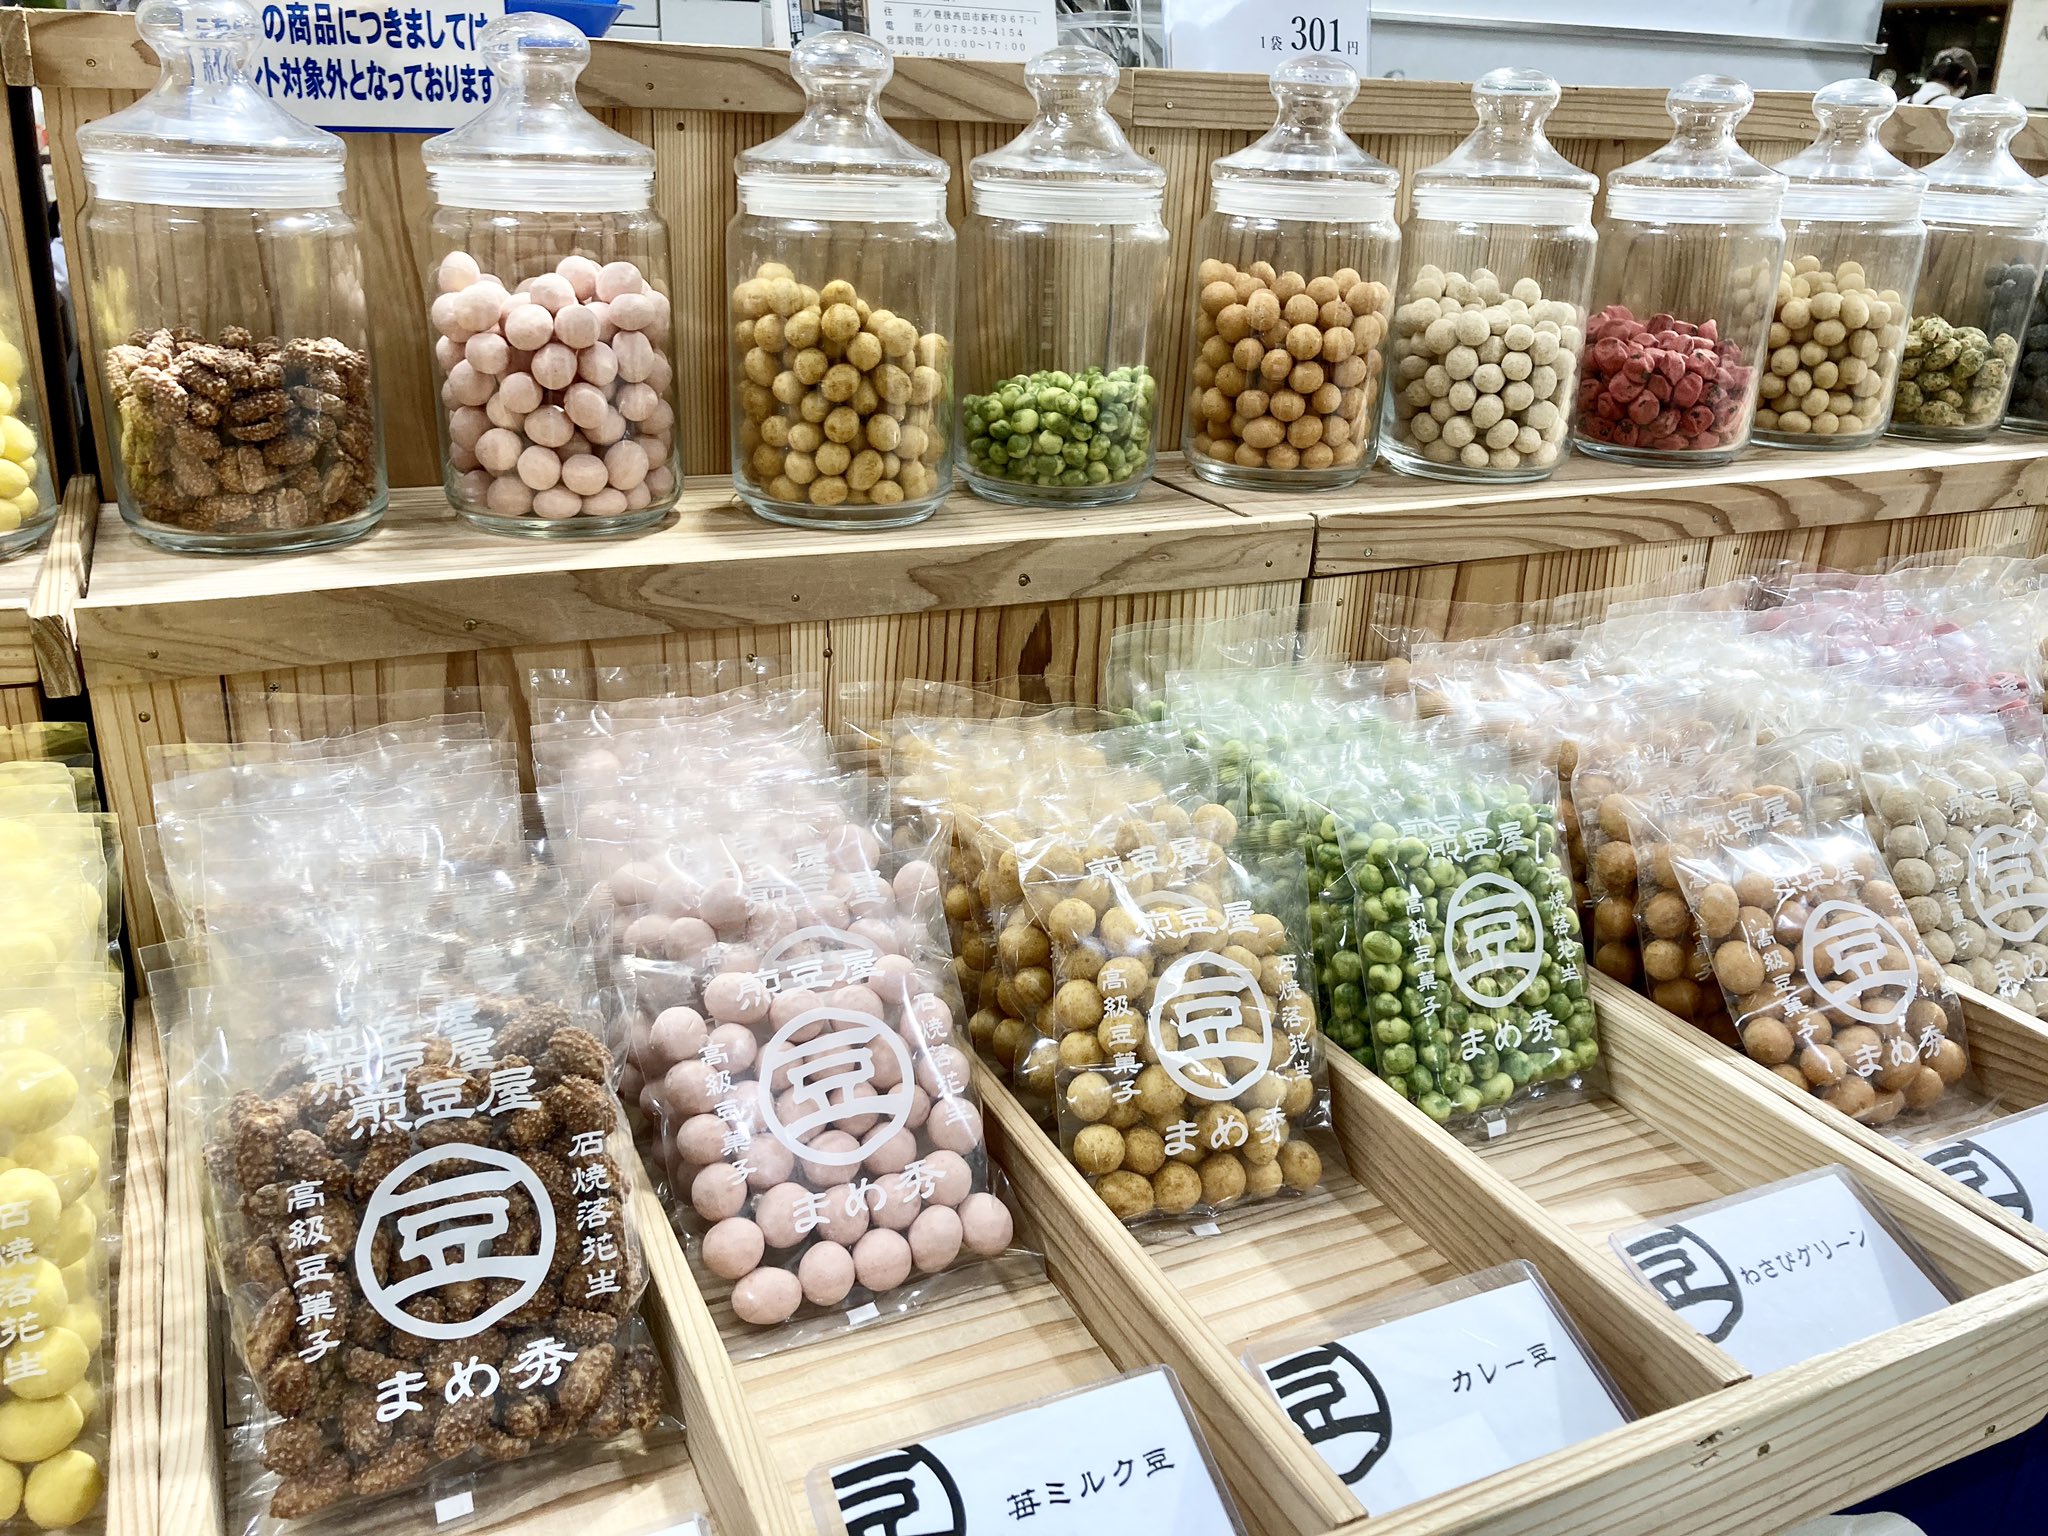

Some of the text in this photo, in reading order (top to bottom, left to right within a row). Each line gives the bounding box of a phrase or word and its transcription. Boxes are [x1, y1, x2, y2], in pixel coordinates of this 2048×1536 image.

[1406, 892, 1441, 1017] 高級豆菓子
[1101, 967, 1143, 1104] 高級豆菓子
[1462, 1010, 1560, 1061] まめ秀
[1857, 1024, 1946, 1077] まめ秀
[347, 1065, 542, 1140] 煎豆屋
[698, 1043, 757, 1185] 高級豆菓子
[569, 1130, 623, 1298] 石焼落花生
[793, 1159, 948, 1234] まめ秀
[286, 1180, 341, 1364] 高級豆菓子
[1740, 1230, 1866, 1286] わさびグリーン
[376, 1336, 579, 1423] まめ秀
[1452, 1342, 1557, 1393] カレー豆
[1007, 1447, 1176, 1521] 苺ミルク豆
